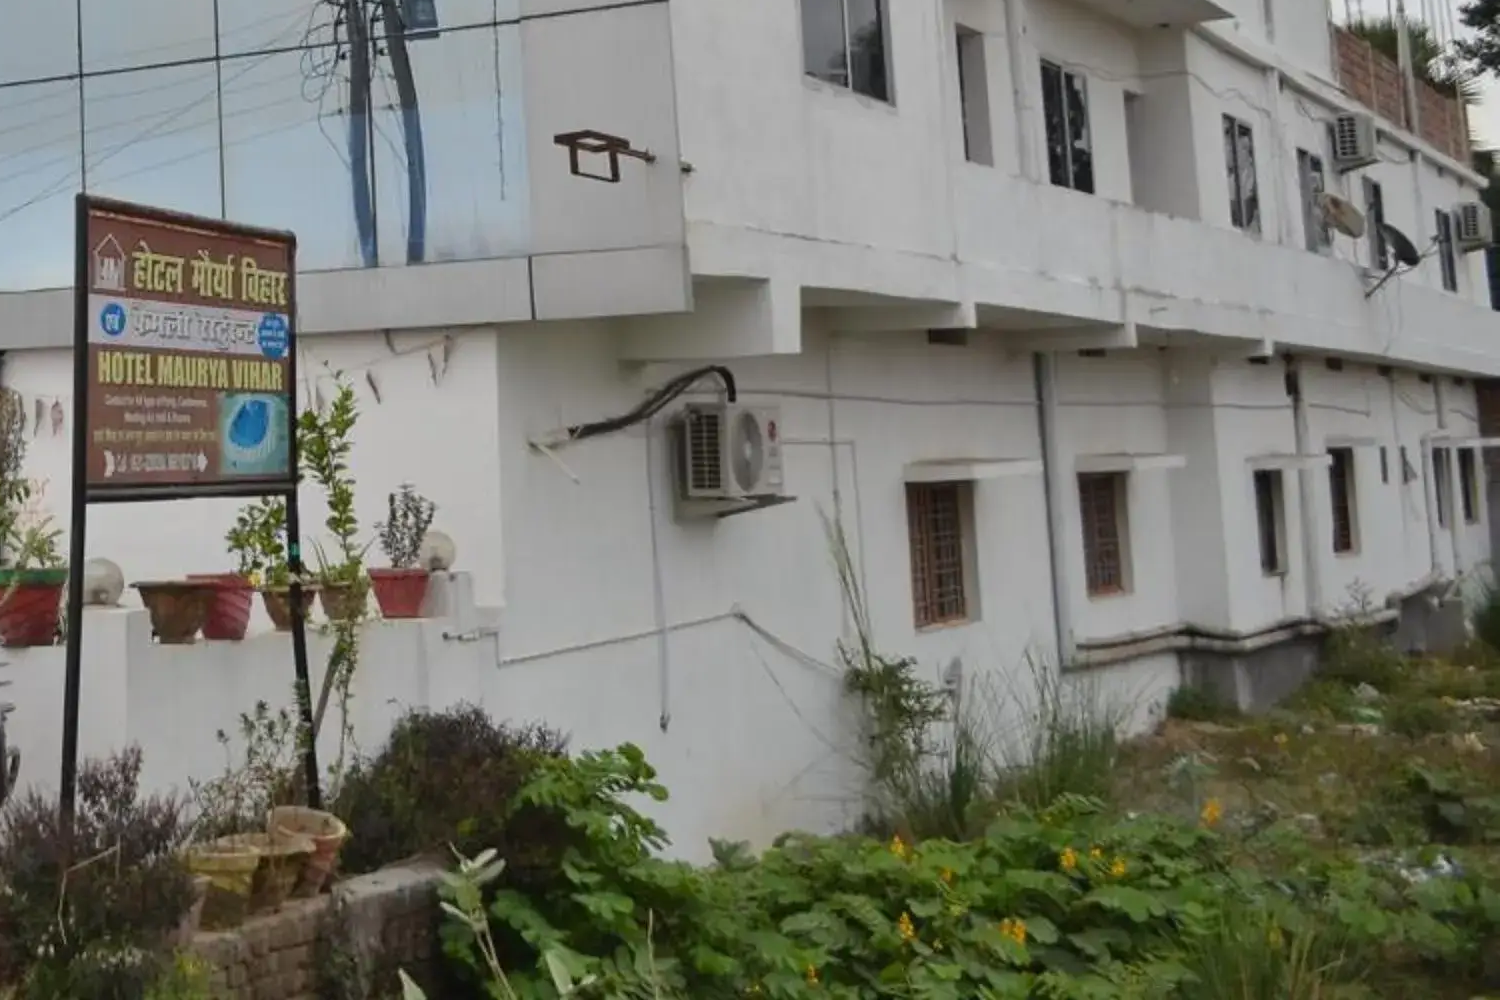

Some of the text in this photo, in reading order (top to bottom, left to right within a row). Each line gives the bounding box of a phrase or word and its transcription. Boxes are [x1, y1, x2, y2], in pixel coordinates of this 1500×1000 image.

[132, 239, 185, 294] होटल
[241, 257, 288, 305] विहार
[97, 350, 284, 391] HOTEL MAURYA VIHAR
